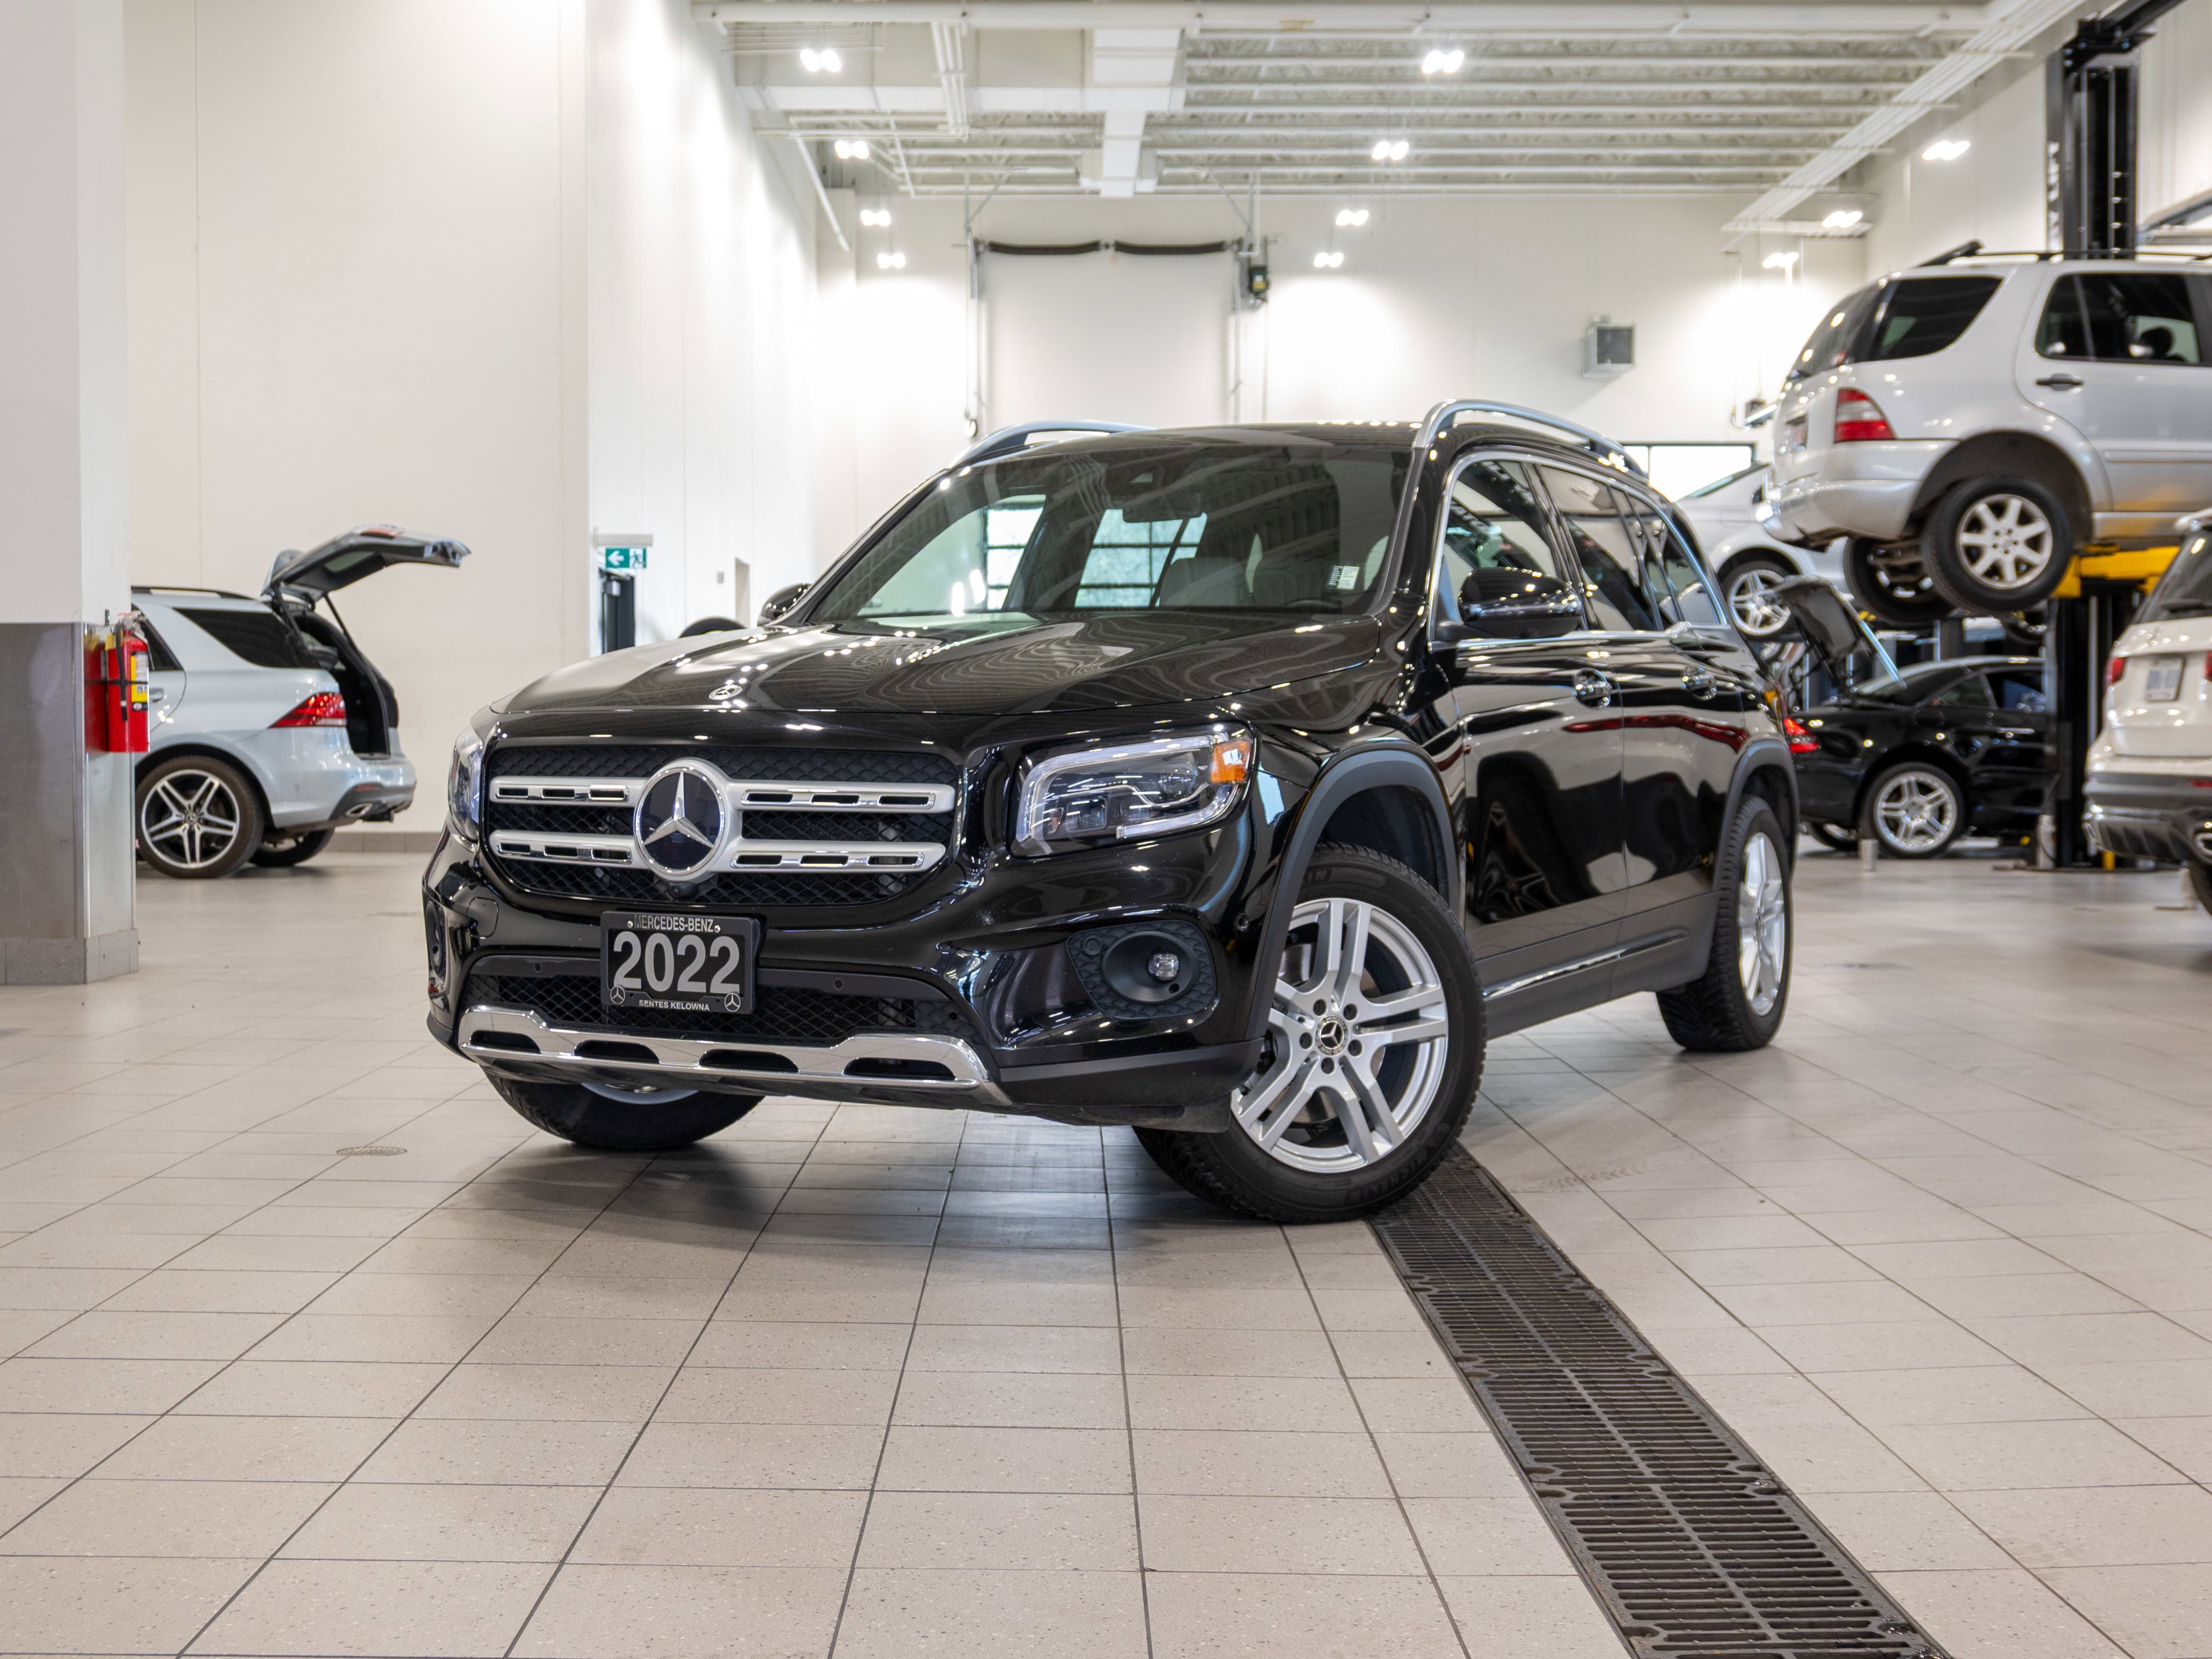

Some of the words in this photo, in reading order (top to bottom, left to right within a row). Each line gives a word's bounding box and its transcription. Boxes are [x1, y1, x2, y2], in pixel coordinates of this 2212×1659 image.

[634, 915, 713, 933] MERCEDES-BENZ
[614, 931, 740, 994] 2022
[639, 999, 668, 1010] SENTES
[670, 1001, 710, 1011] KELOWNA
